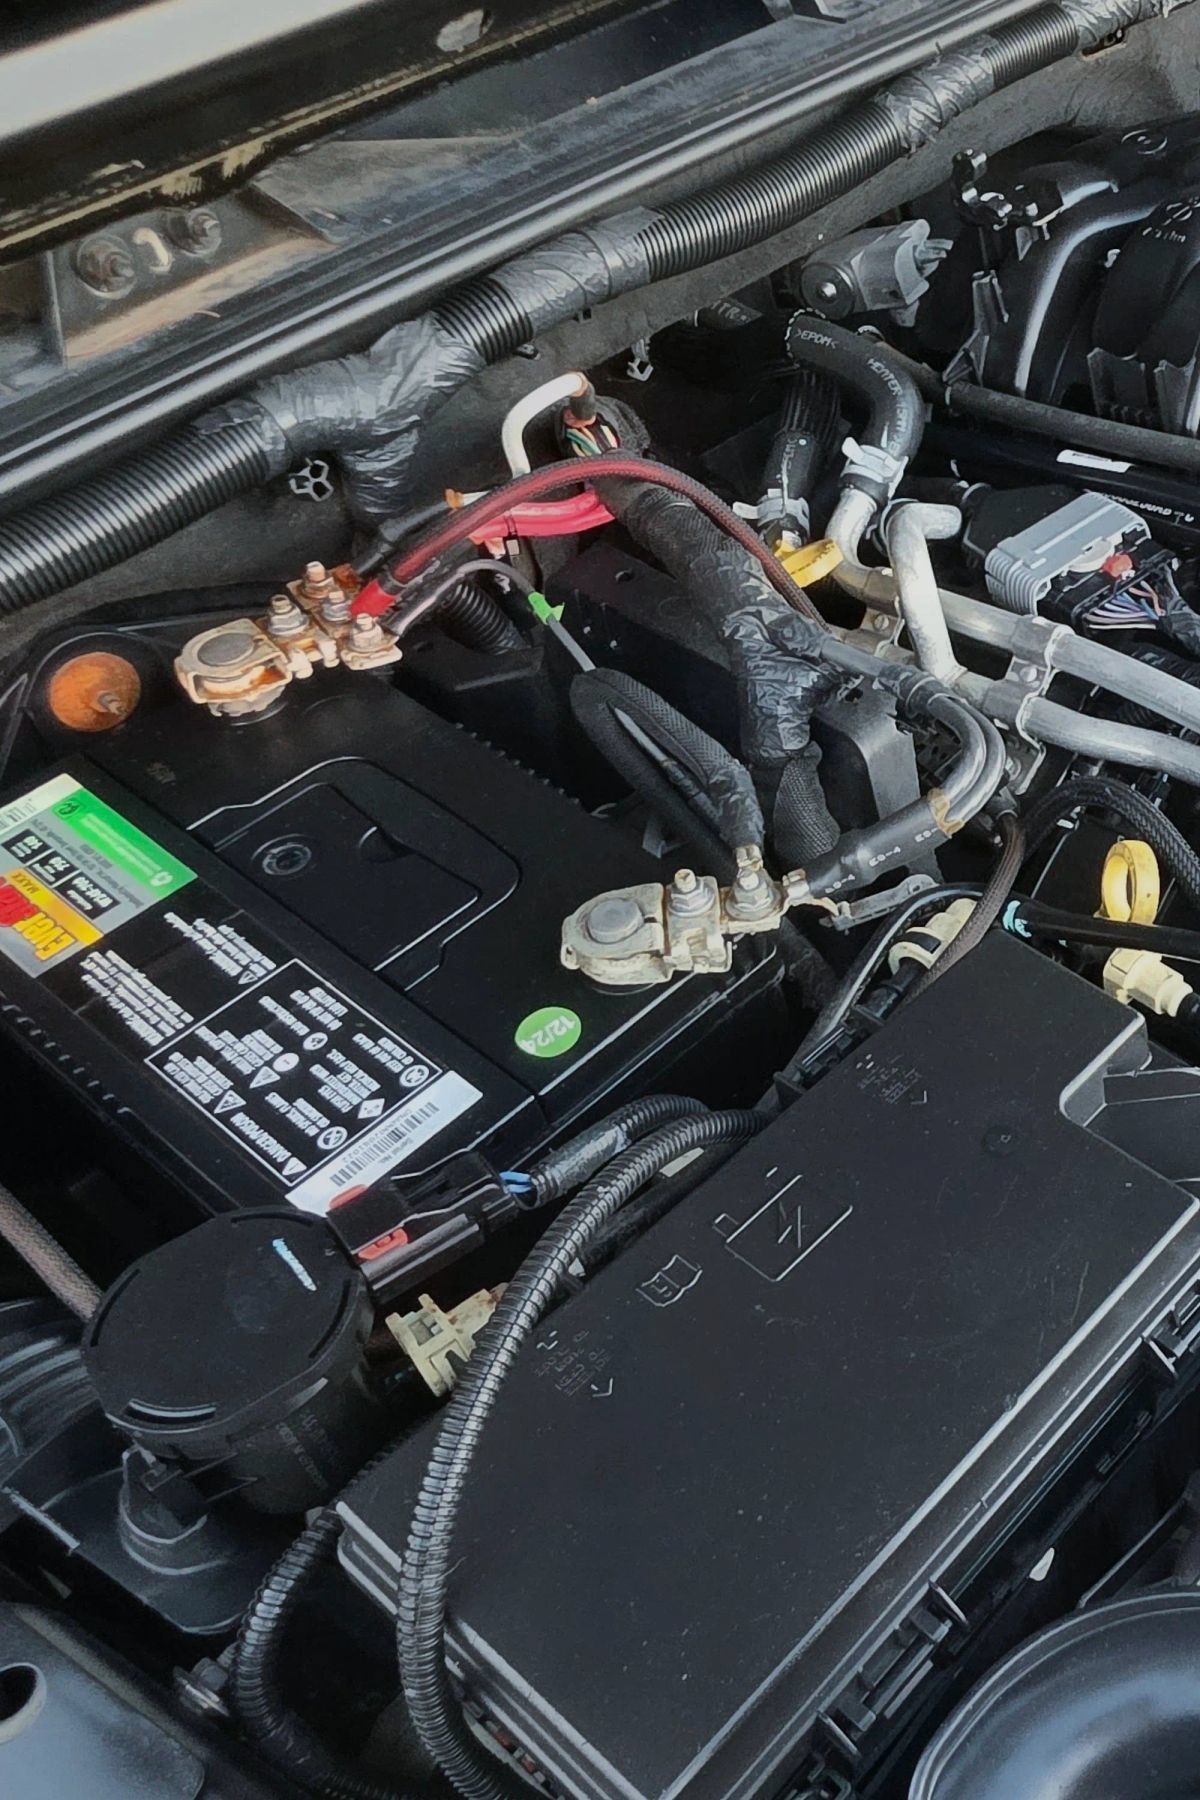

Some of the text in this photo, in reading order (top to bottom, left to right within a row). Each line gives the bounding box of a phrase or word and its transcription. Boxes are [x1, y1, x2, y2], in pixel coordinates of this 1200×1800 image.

[12, 872, 41, 894] MAXX
[0, 876, 77, 961] EverSta
[521, 1016, 576, 1054] 12/24
[227, 1110, 292, 1163] DANGER/POISON
